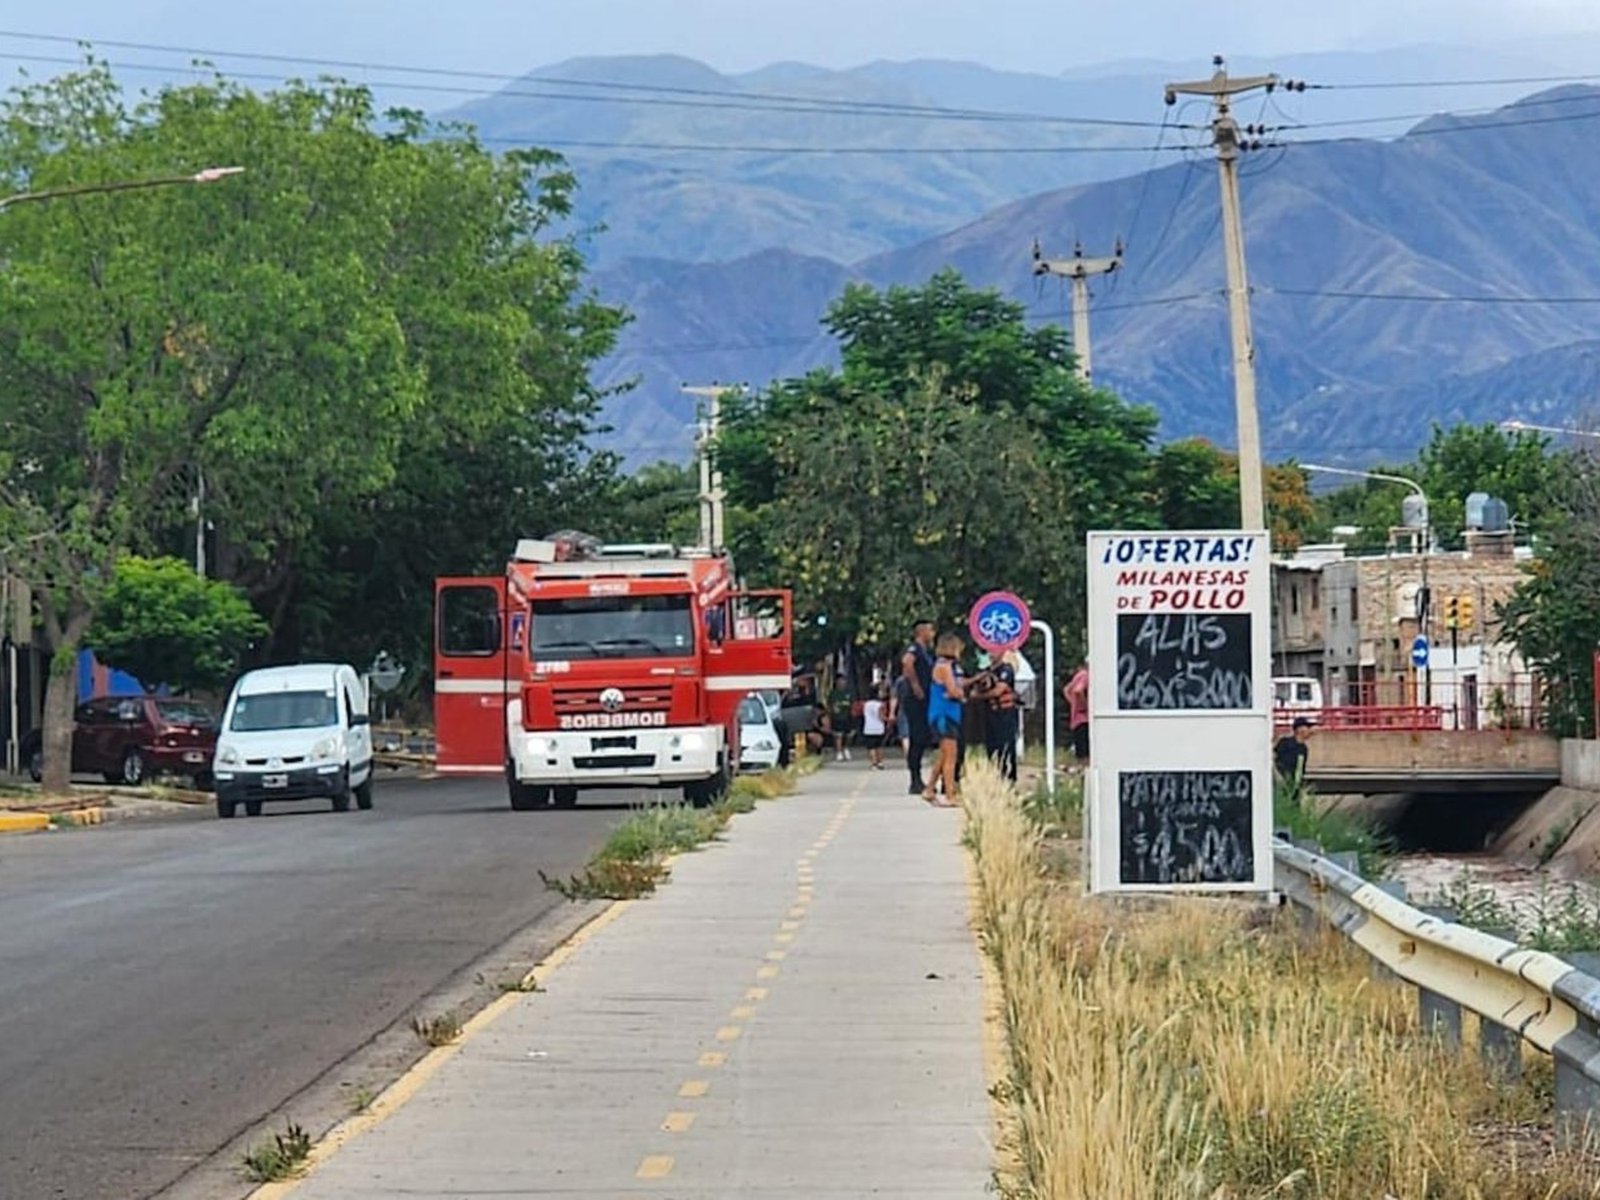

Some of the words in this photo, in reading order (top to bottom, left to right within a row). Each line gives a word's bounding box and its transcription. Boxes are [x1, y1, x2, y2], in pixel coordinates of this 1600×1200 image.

[1103, 538, 1254, 564] ¡OFERTAS!
[1117, 570, 1249, 586] MILANESAS
[1117, 597, 1142, 609] DE
[1150, 589, 1246, 610] POLLO
[1135, 615, 1227, 656] ALAS
